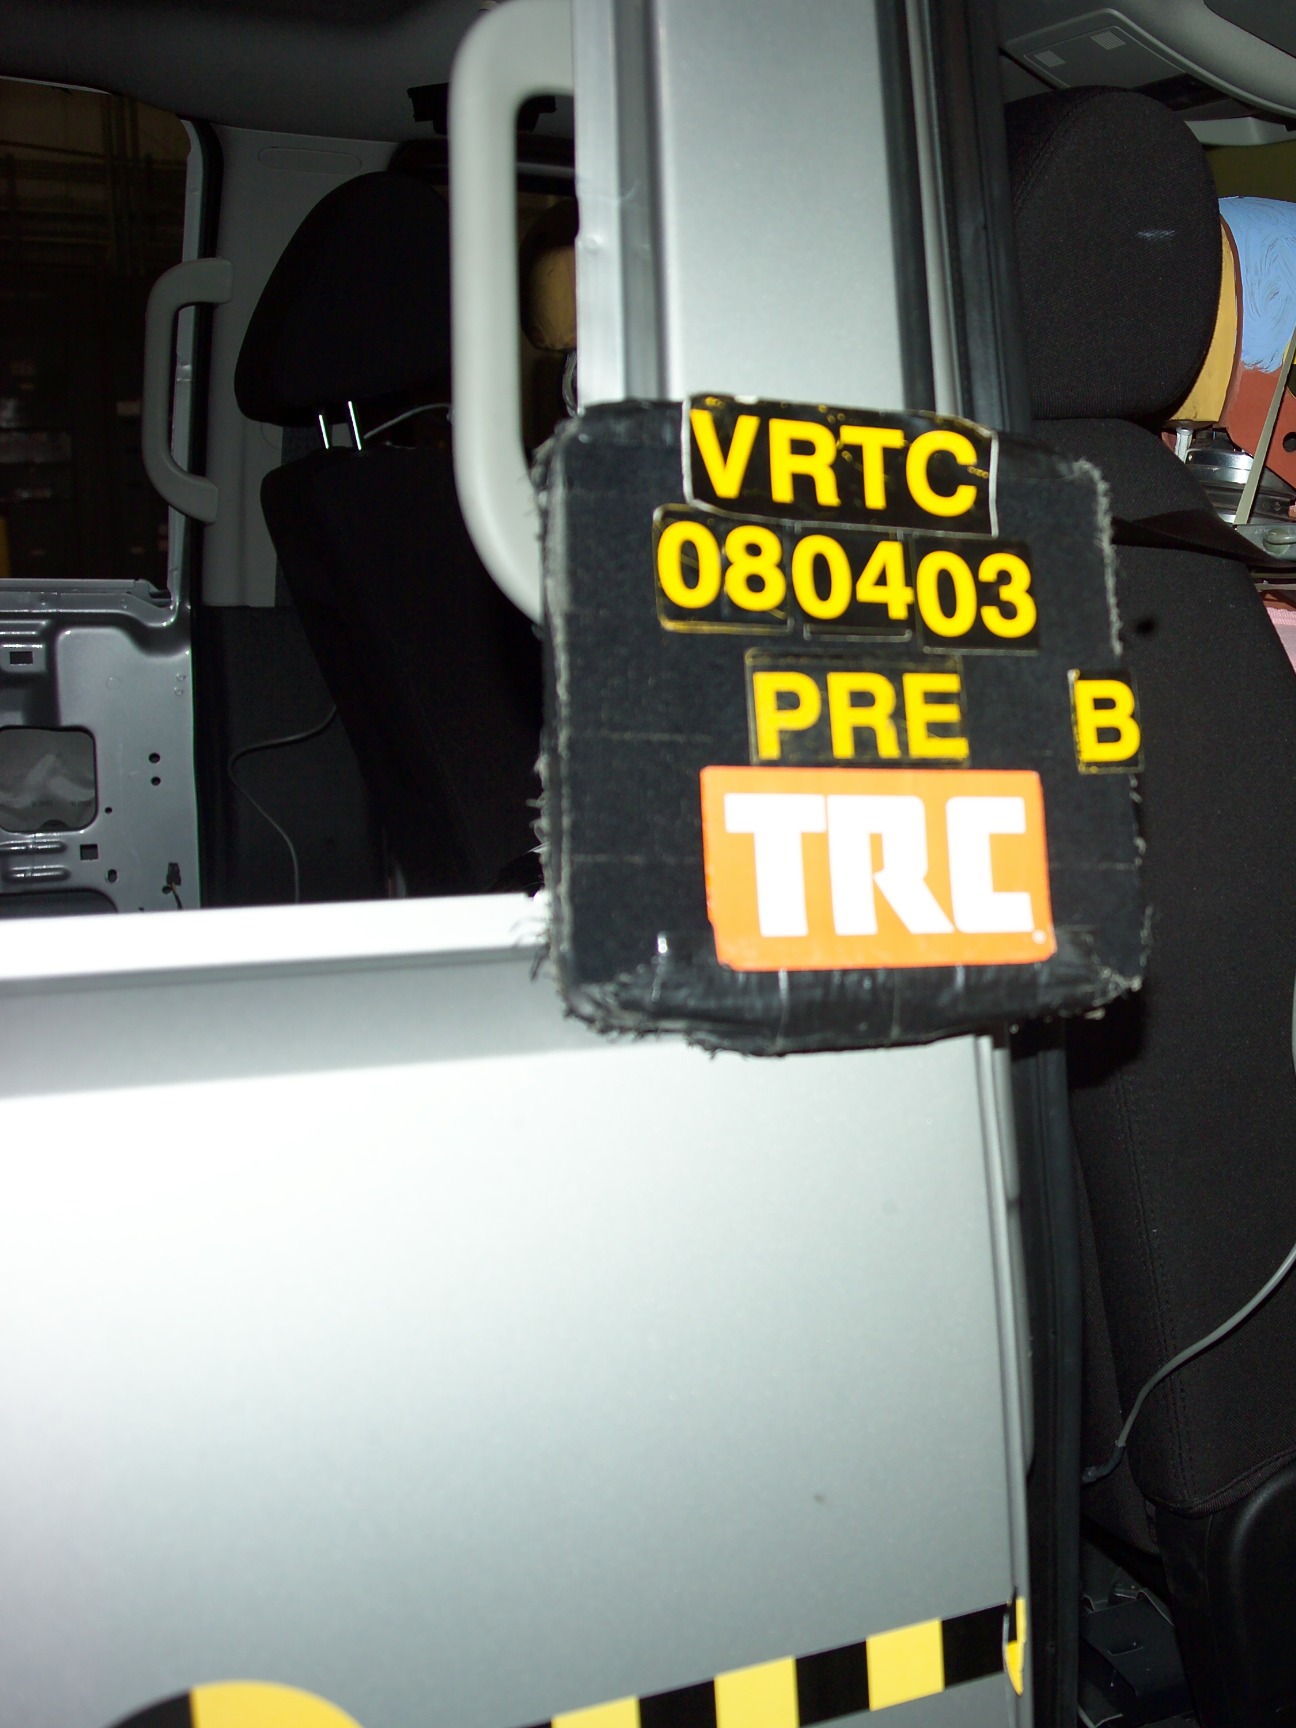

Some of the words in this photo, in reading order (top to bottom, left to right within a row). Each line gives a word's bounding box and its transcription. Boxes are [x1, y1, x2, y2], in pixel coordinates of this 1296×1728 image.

[689, 408, 977, 517] VRTC
[656, 520, 1037, 638] 080403
[752, 671, 970, 760] PRE
[1072, 678, 1141, 763] B
[723, 792, 1036, 938] TRC
